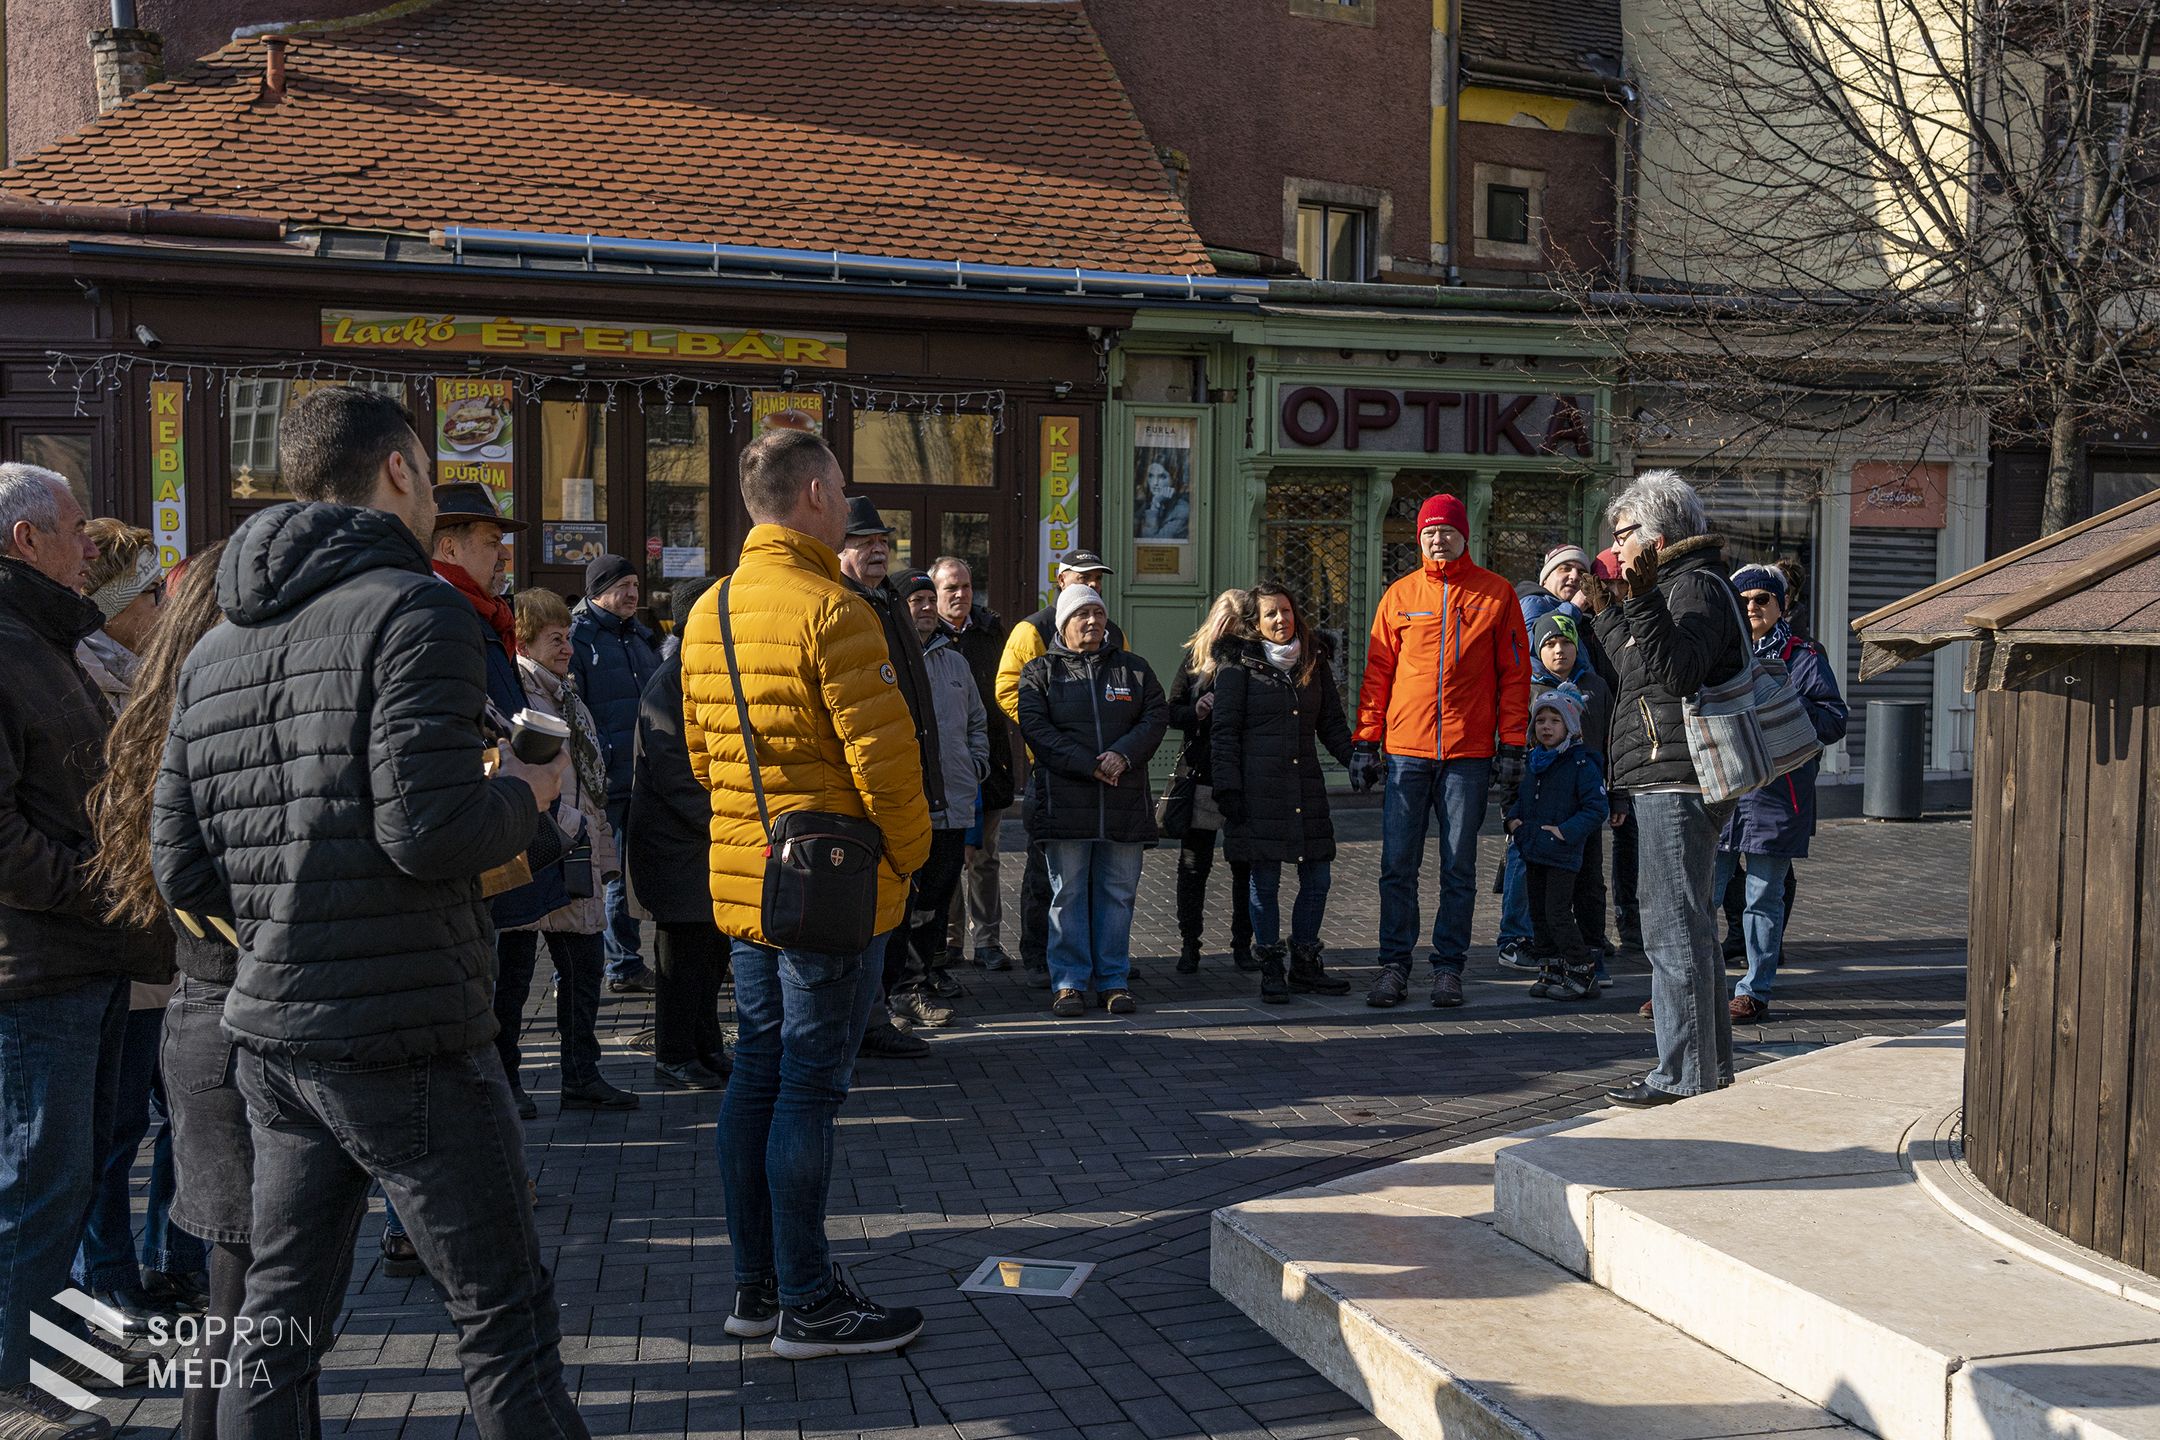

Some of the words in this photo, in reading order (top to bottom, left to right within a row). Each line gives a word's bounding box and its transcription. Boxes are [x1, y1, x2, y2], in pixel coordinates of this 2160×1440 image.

[332, 315, 456, 347] Lackó
[481, 316, 830, 364] ÉTELBÁR
[442, 381, 506, 402] KEBAB
[755, 395, 821, 421] HAMBURGER
[1145, 425, 1176, 434] FURLA
[1282, 386, 1594, 458] OPTIKA
[157, 392, 180, 532] KEBAB
[444, 463, 506, 488] DÜRÜM
[1049, 426, 1070, 550] KEBAB
